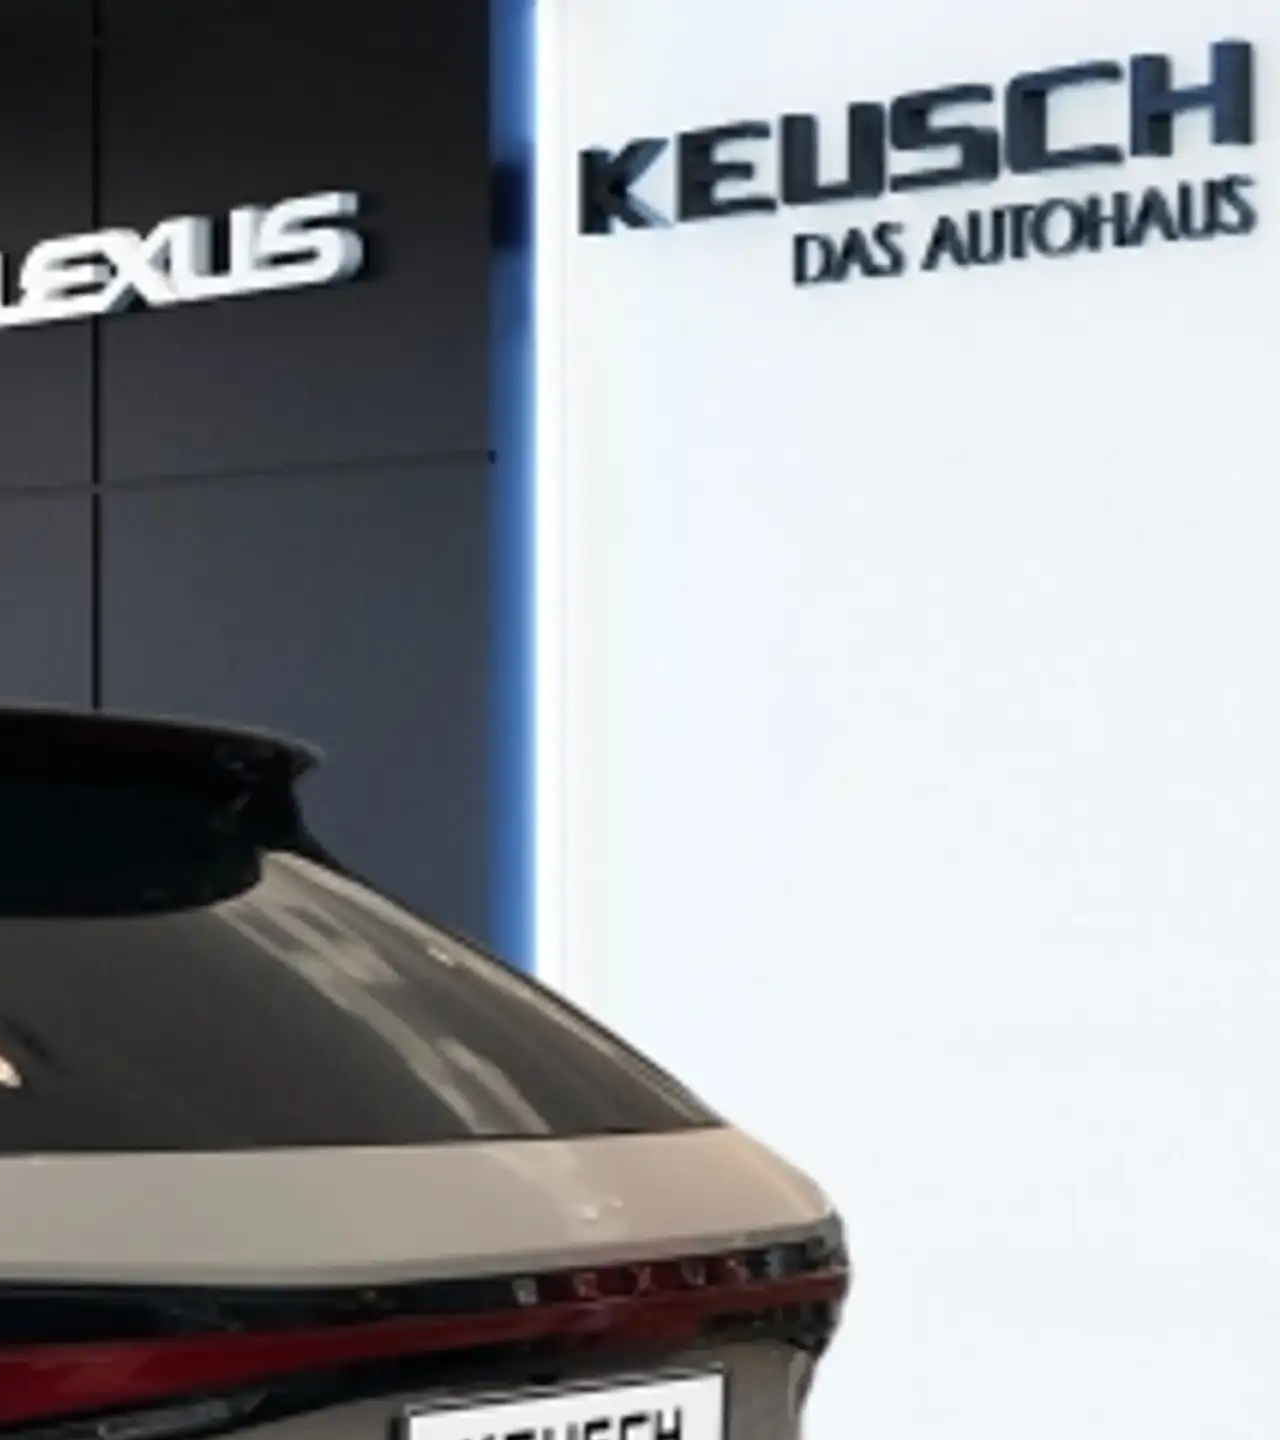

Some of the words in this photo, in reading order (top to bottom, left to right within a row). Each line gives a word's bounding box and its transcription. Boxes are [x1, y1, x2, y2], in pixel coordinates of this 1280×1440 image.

[576, 38, 1256, 236] KEUSCH
[793, 221, 907, 287] DAS
[919, 174, 1258, 272] AUTOHAUS
